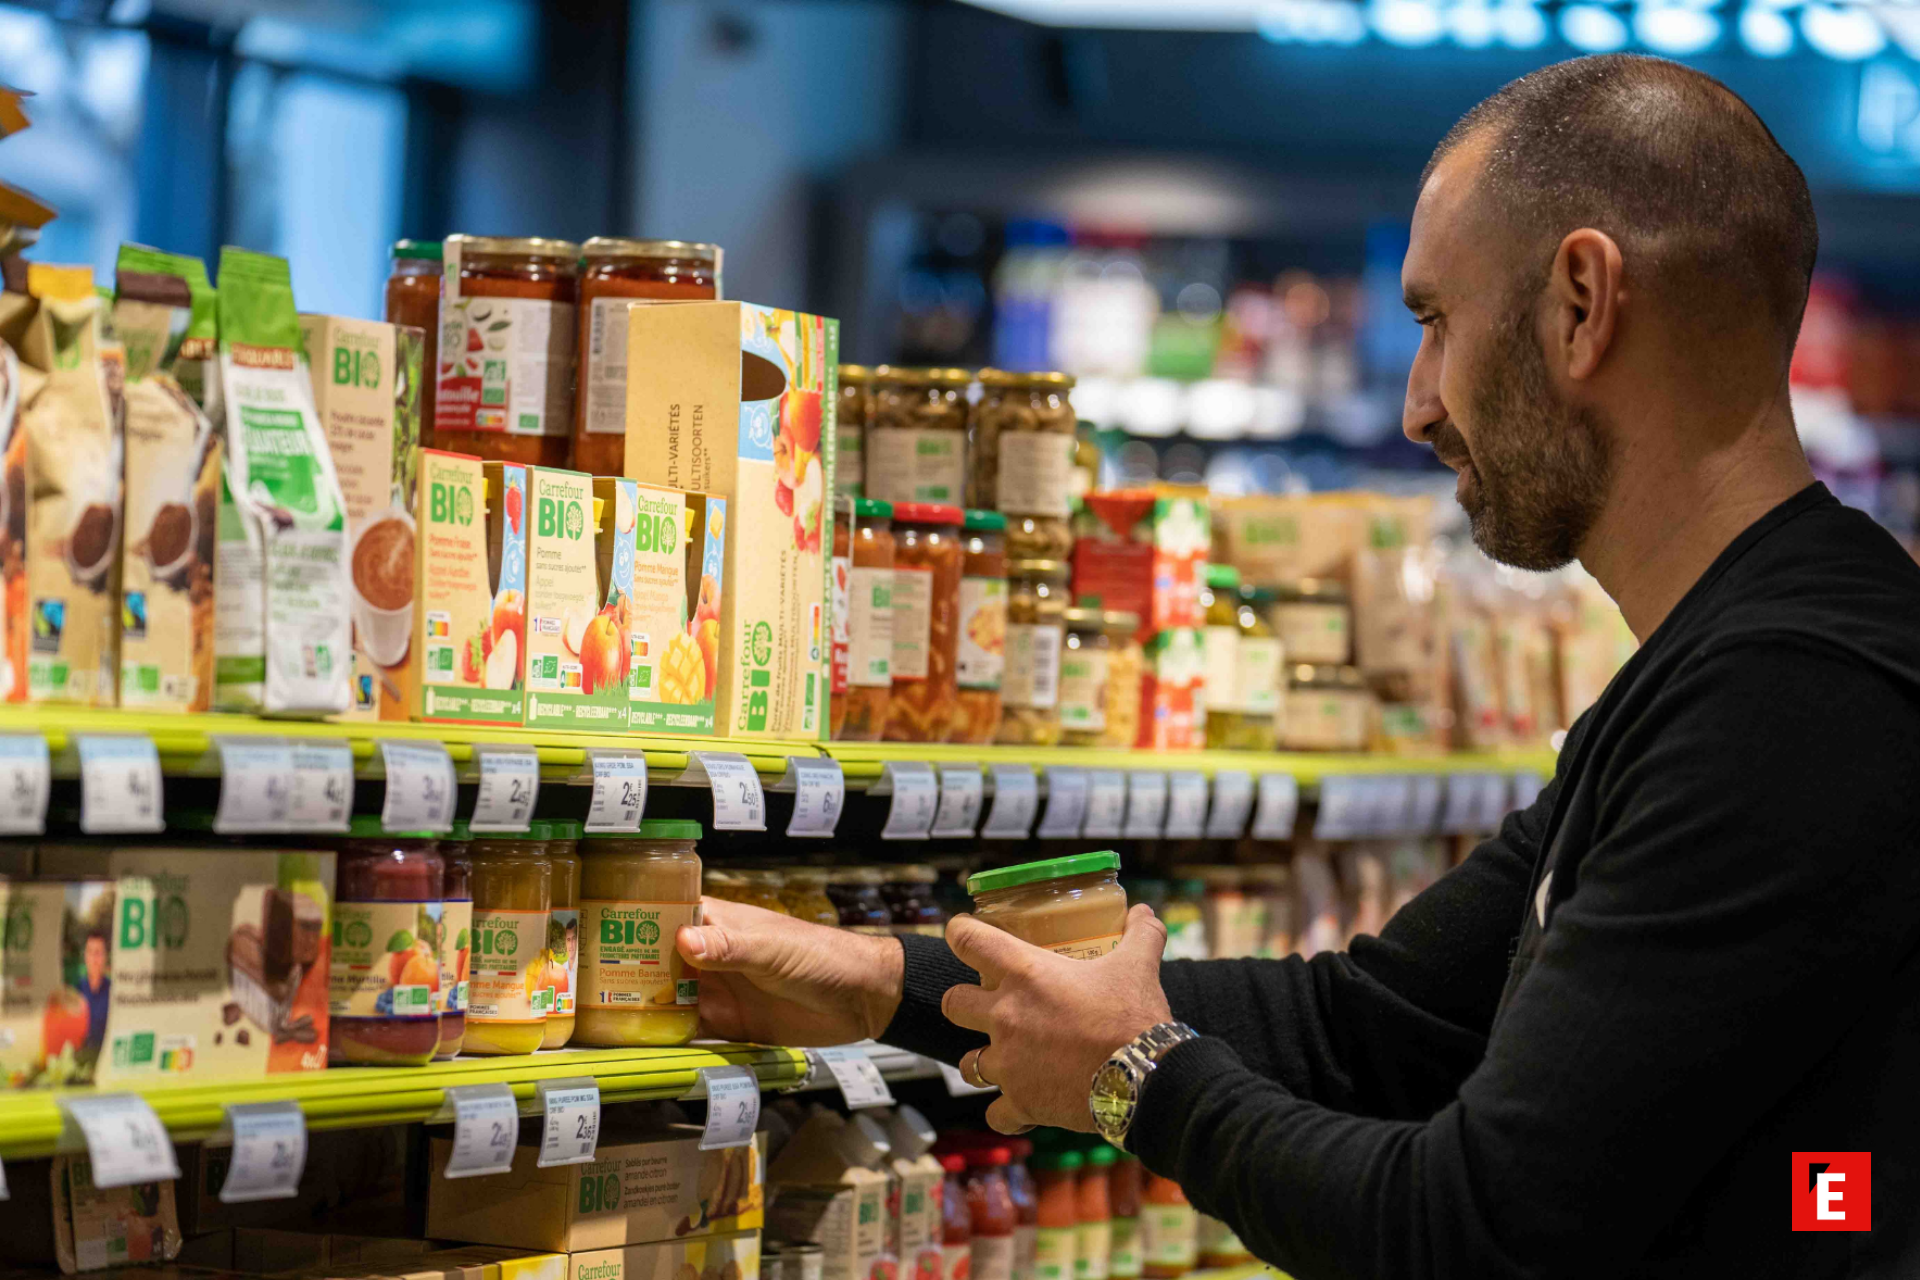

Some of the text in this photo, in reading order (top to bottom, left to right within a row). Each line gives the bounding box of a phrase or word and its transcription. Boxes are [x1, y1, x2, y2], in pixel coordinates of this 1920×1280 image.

[334, 347, 380, 389] BIO
[539, 479, 584, 500] Carrefour
[431, 483, 473, 527] BIO
[637, 495, 678, 516] Carrefour
[538, 497, 584, 541] BIO
[636, 513, 677, 555] BIO
[536, 546, 562, 560] Pomme
[633, 560, 656, 574] Pomme
[738, 620, 752, 731] Carrefour
[746, 621, 773, 732] BIO
[617, 706, 627, 719] x4
[704, 716, 714, 728] x4
[600, 907, 661, 920] Carrefour
[471, 928, 518, 956] BIO
[600, 919, 661, 946] BIO
[600, 967, 671, 978] Pomme Banane
[492, 980, 524, 991] Mangue
[580, 1157, 622, 1176] Carrefour
[624, 1168, 667, 1181] amande citron
[579, 1173, 621, 1214] BIO
[578, 1260, 622, 1280] Carrefour
